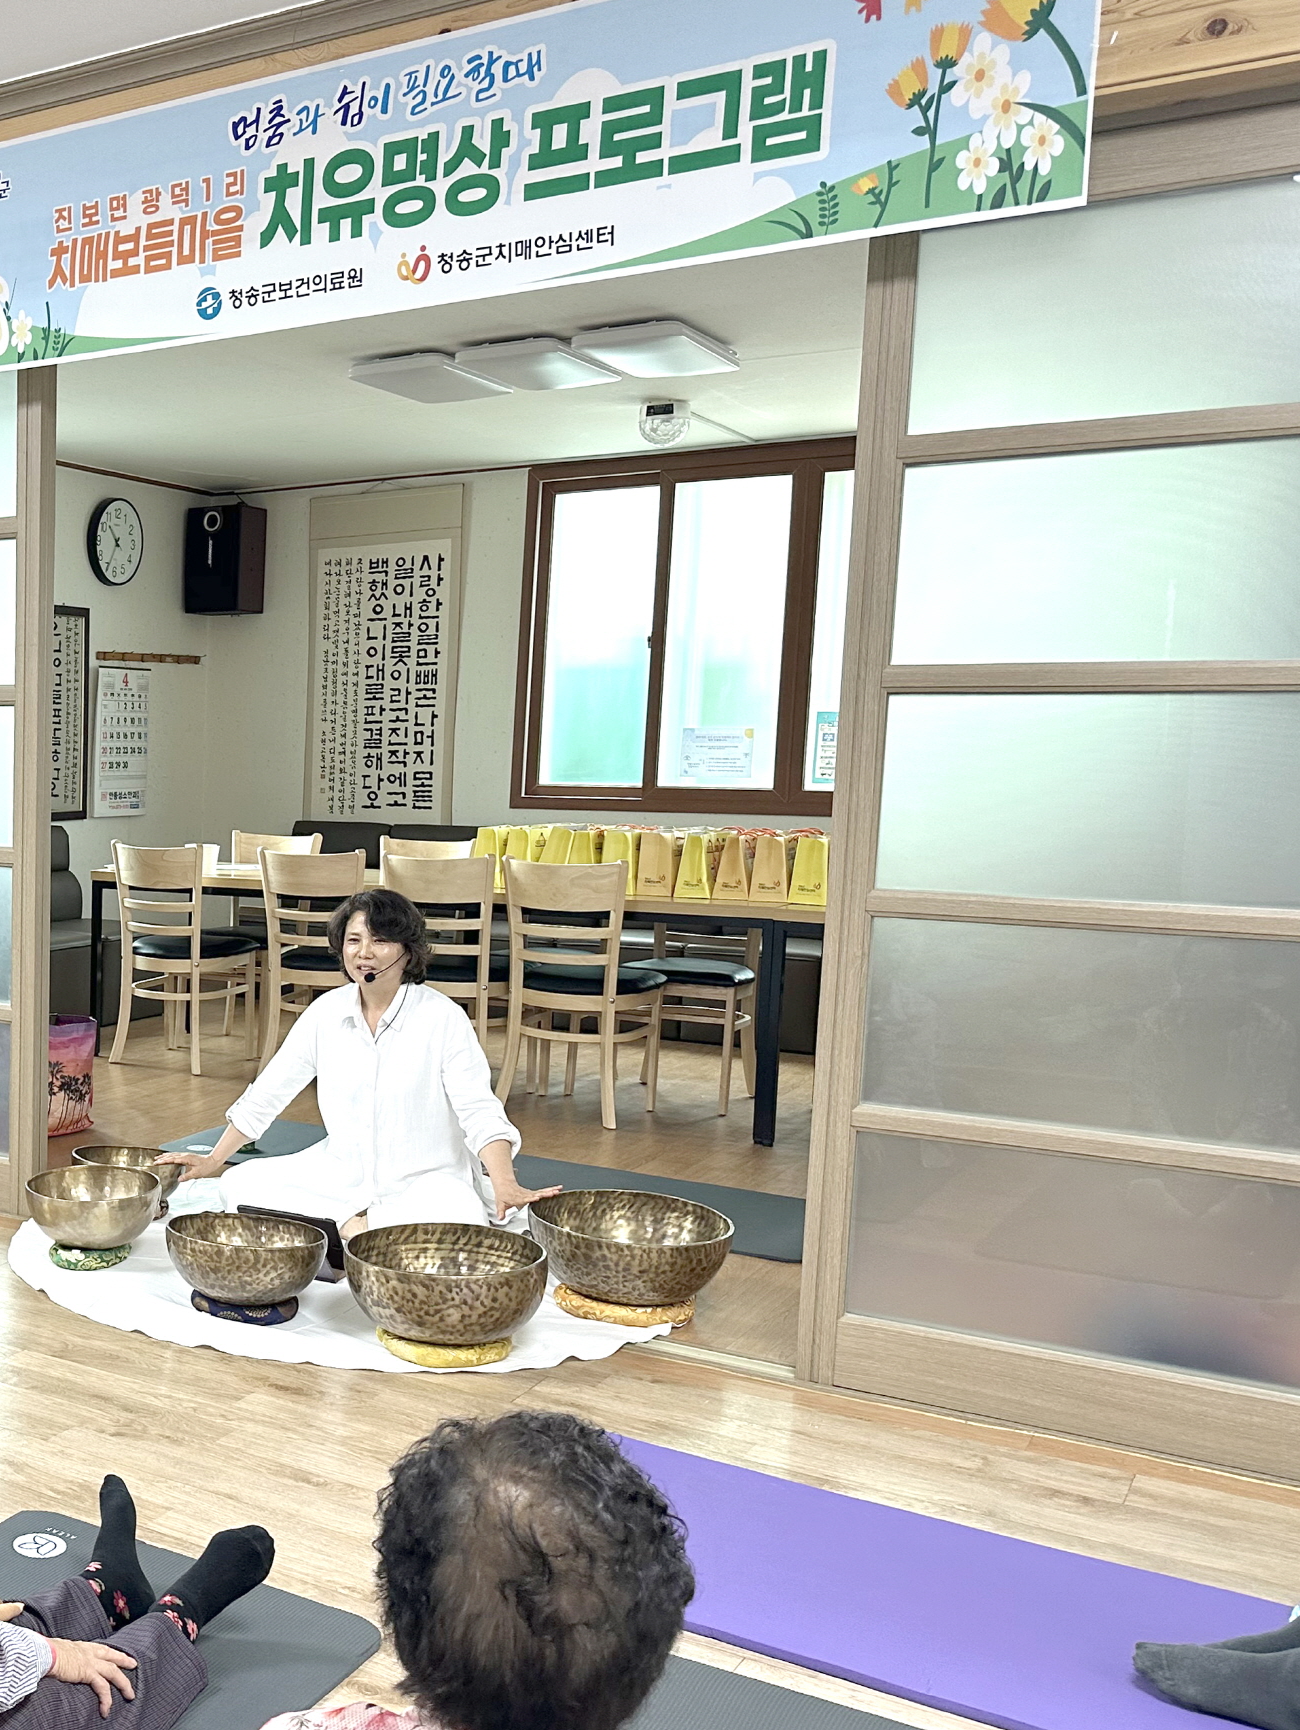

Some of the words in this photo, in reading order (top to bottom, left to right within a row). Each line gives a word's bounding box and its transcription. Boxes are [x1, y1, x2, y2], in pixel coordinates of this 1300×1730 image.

[231, 100, 325, 151] 멈춤과
[334, 81, 390, 128] 쉼이
[260, 116, 511, 249] 치유명상
[523, 47, 828, 203] 프로그램
[54, 193, 128, 232] 진보면
[47, 204, 243, 291] 치매보듬마을
[437, 225, 615, 272] 청송군치매안심센터
[229, 268, 364, 310] 청송군보건의료원
[106, 512, 111, 522] 11
[114, 508, 121, 519] 12
[100, 522, 107, 532] 10
[129, 524, 134, 535] 2
[96, 535, 101, 546] 9
[130, 540, 135, 550] 3
[99, 550, 103, 561] 8
[127, 554, 132, 564] 4
[112, 566, 117, 577] 6
[120, 564, 125, 574] 5
[122, 673, 129, 687] 4
[109, 732, 114, 740] 14
[115, 761, 121, 769] 29
[122, 761, 128, 769] 30
